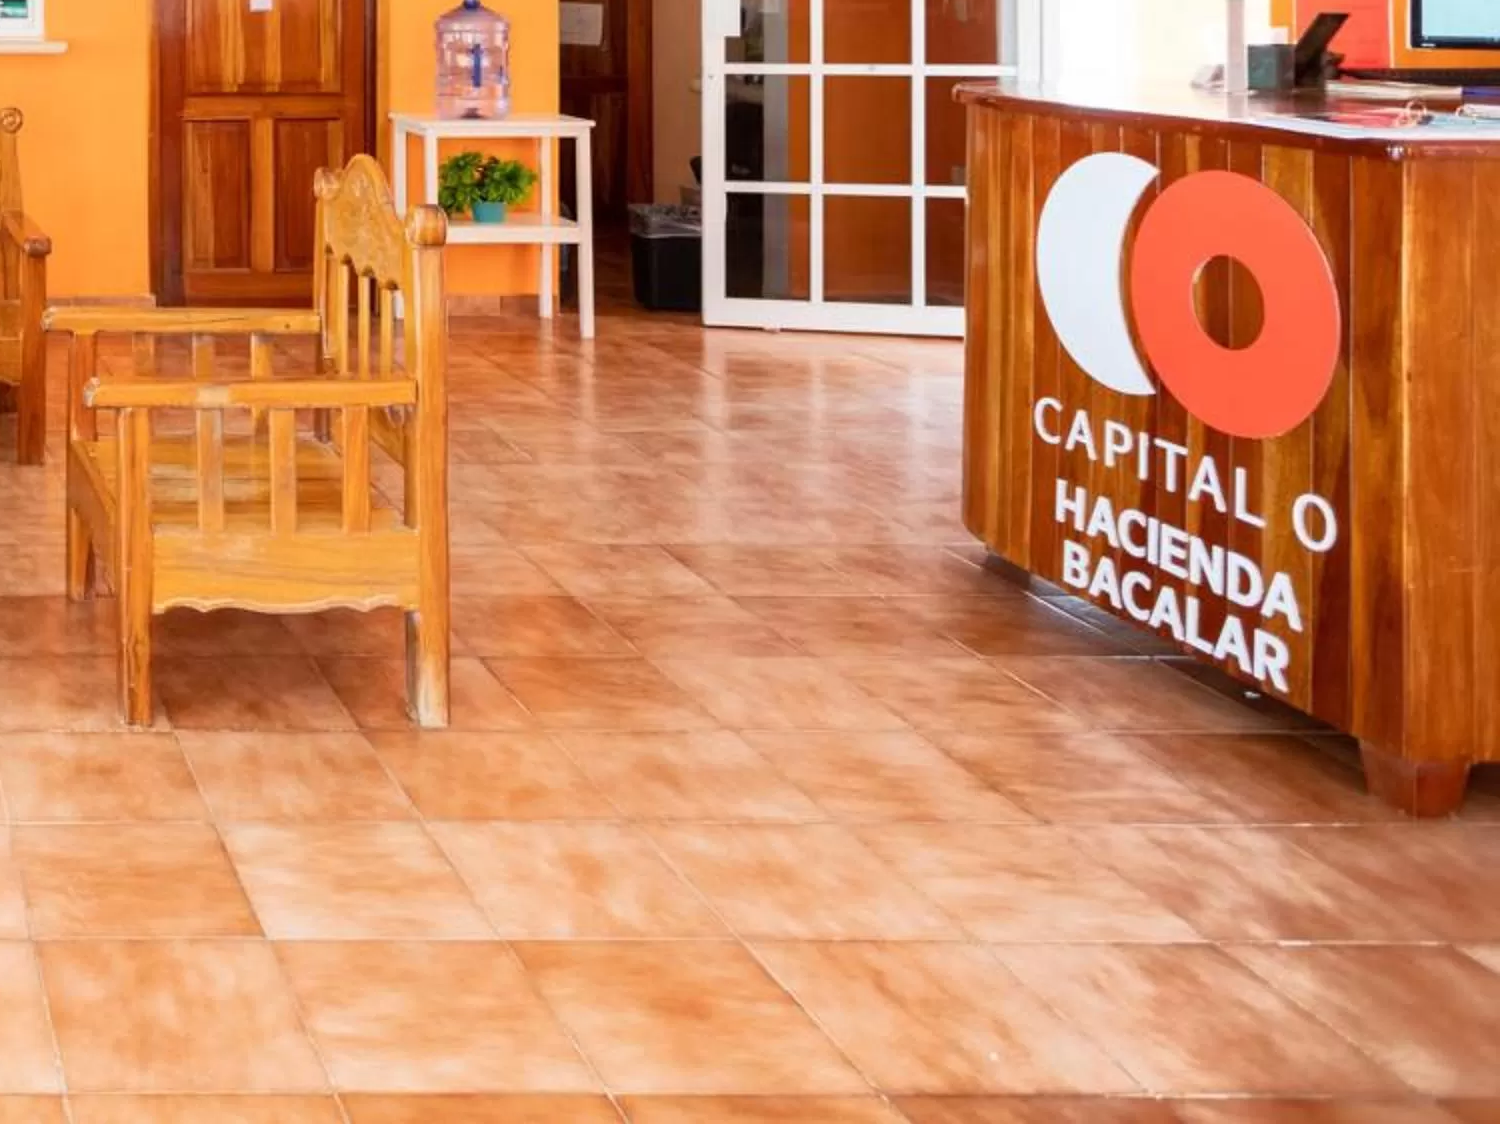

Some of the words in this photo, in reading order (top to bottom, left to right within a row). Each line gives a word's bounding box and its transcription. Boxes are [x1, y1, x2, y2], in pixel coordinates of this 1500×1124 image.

[1034, 397, 1266, 528] CAPITAL
[1292, 493, 1338, 553] O
[1055, 478, 1303, 632] HACIENDA
[1063, 539, 1289, 693] BACALAR
